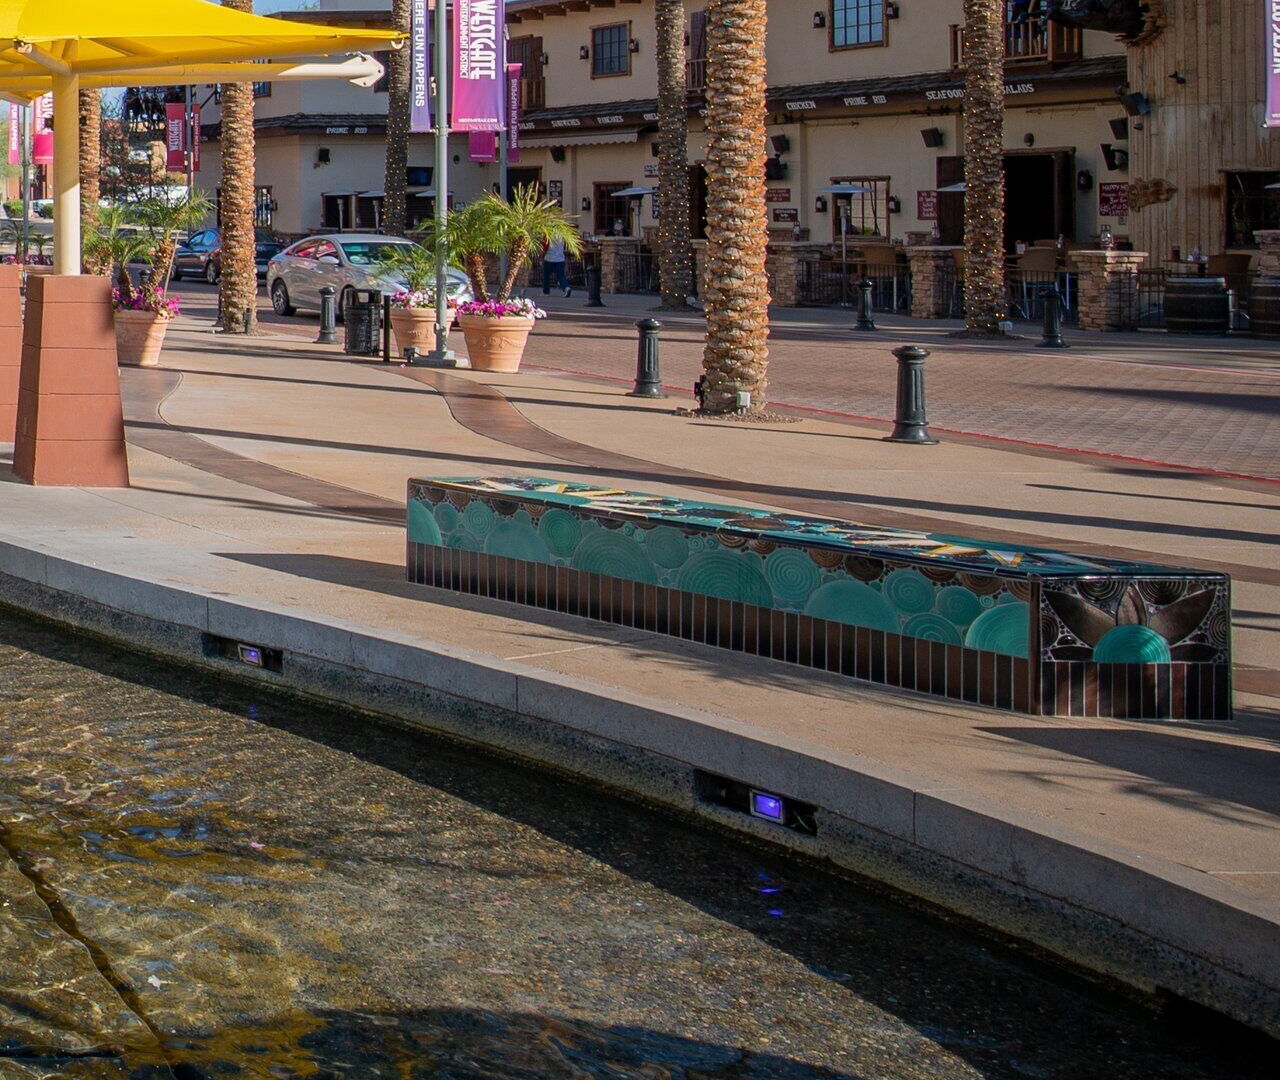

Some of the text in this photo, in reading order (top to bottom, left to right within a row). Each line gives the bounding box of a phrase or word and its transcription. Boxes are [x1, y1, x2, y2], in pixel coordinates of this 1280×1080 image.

[414, 29, 425, 50] FUN
[470, 0, 498, 80] WESTGATE
[414, 54, 425, 107] HAPPENS
[786, 94, 887, 111] CHICKEN PRIME RIB
[926, 88, 964, 101] SEAFOOD
